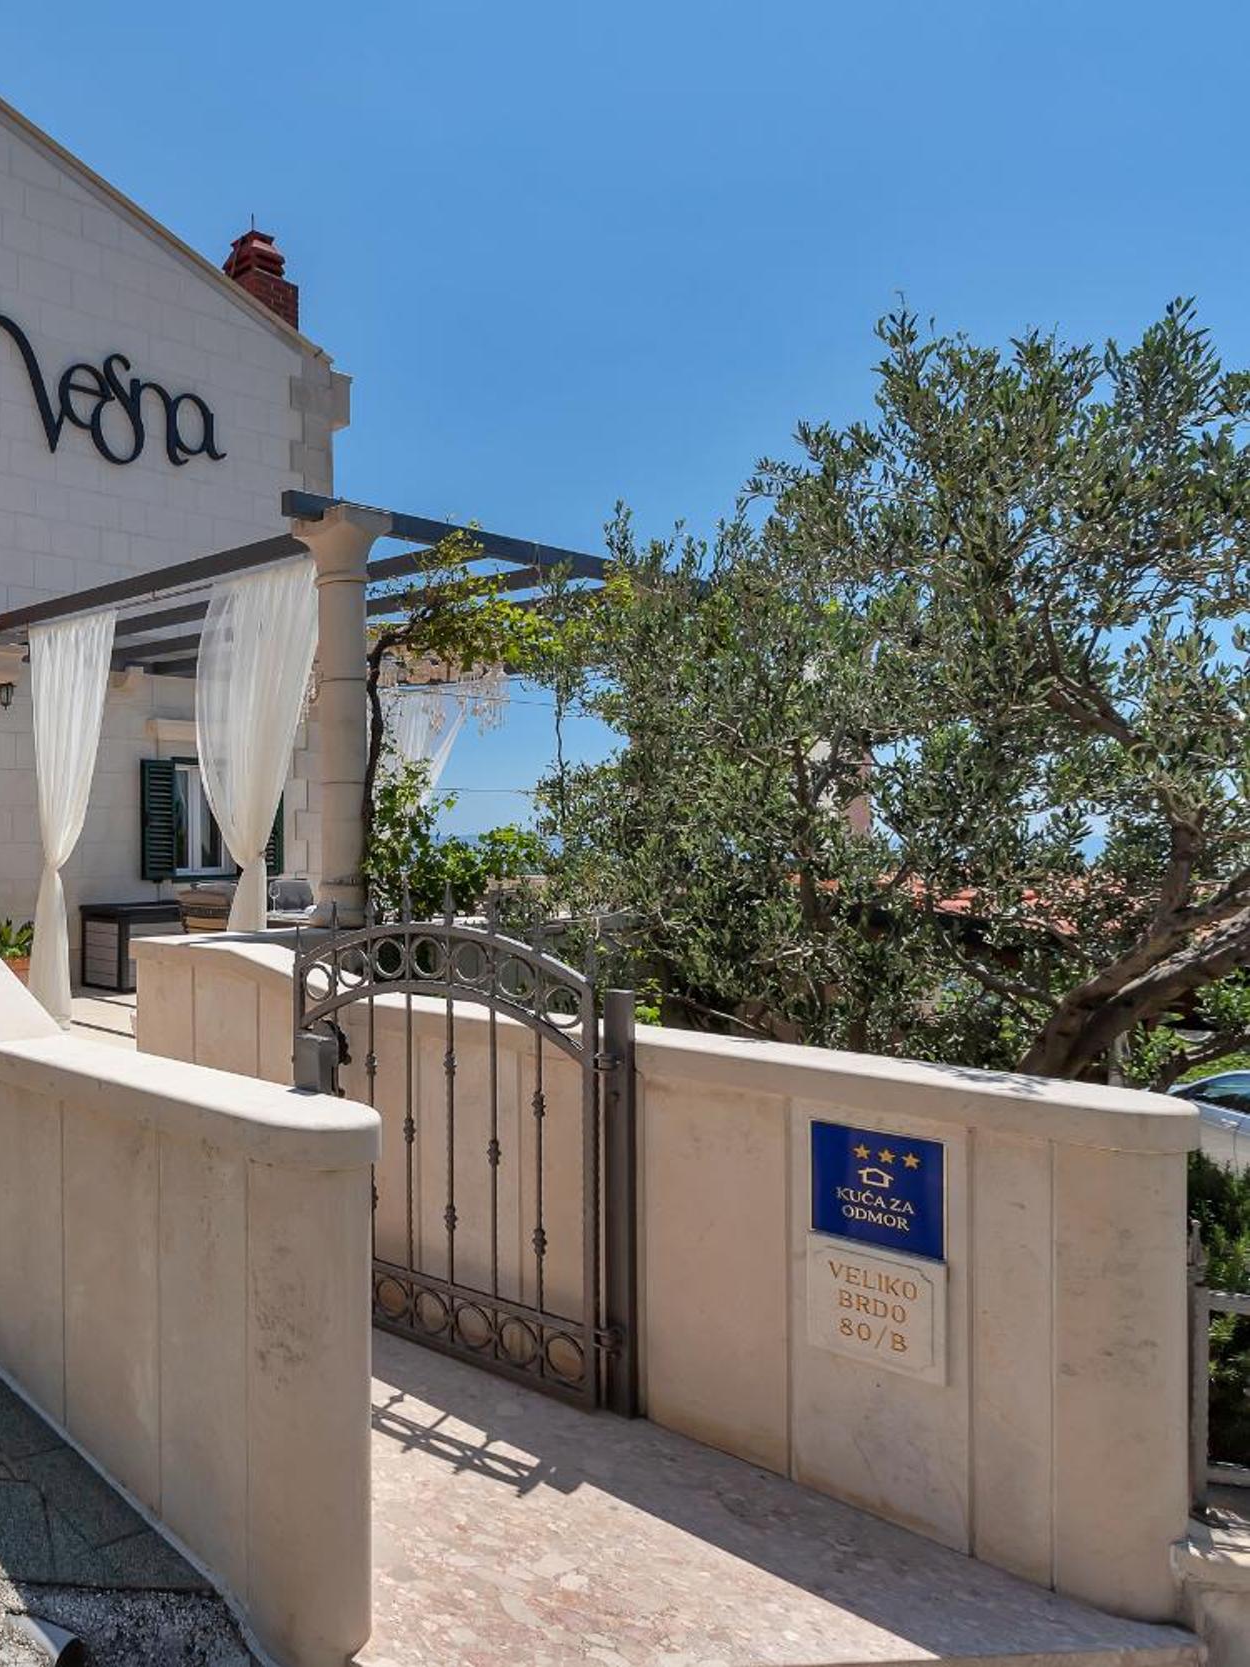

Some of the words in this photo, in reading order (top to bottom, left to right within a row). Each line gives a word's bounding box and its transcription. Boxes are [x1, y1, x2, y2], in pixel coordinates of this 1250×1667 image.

[836, 1186, 886, 1210] KUĆA
[890, 1198, 914, 1215] ZA
[842, 1205, 910, 1232] ODMOR
[828, 1260, 917, 1301] VELIKO
[838, 1289, 906, 1324] BRDO
[839, 1317, 908, 1353] 80/B
